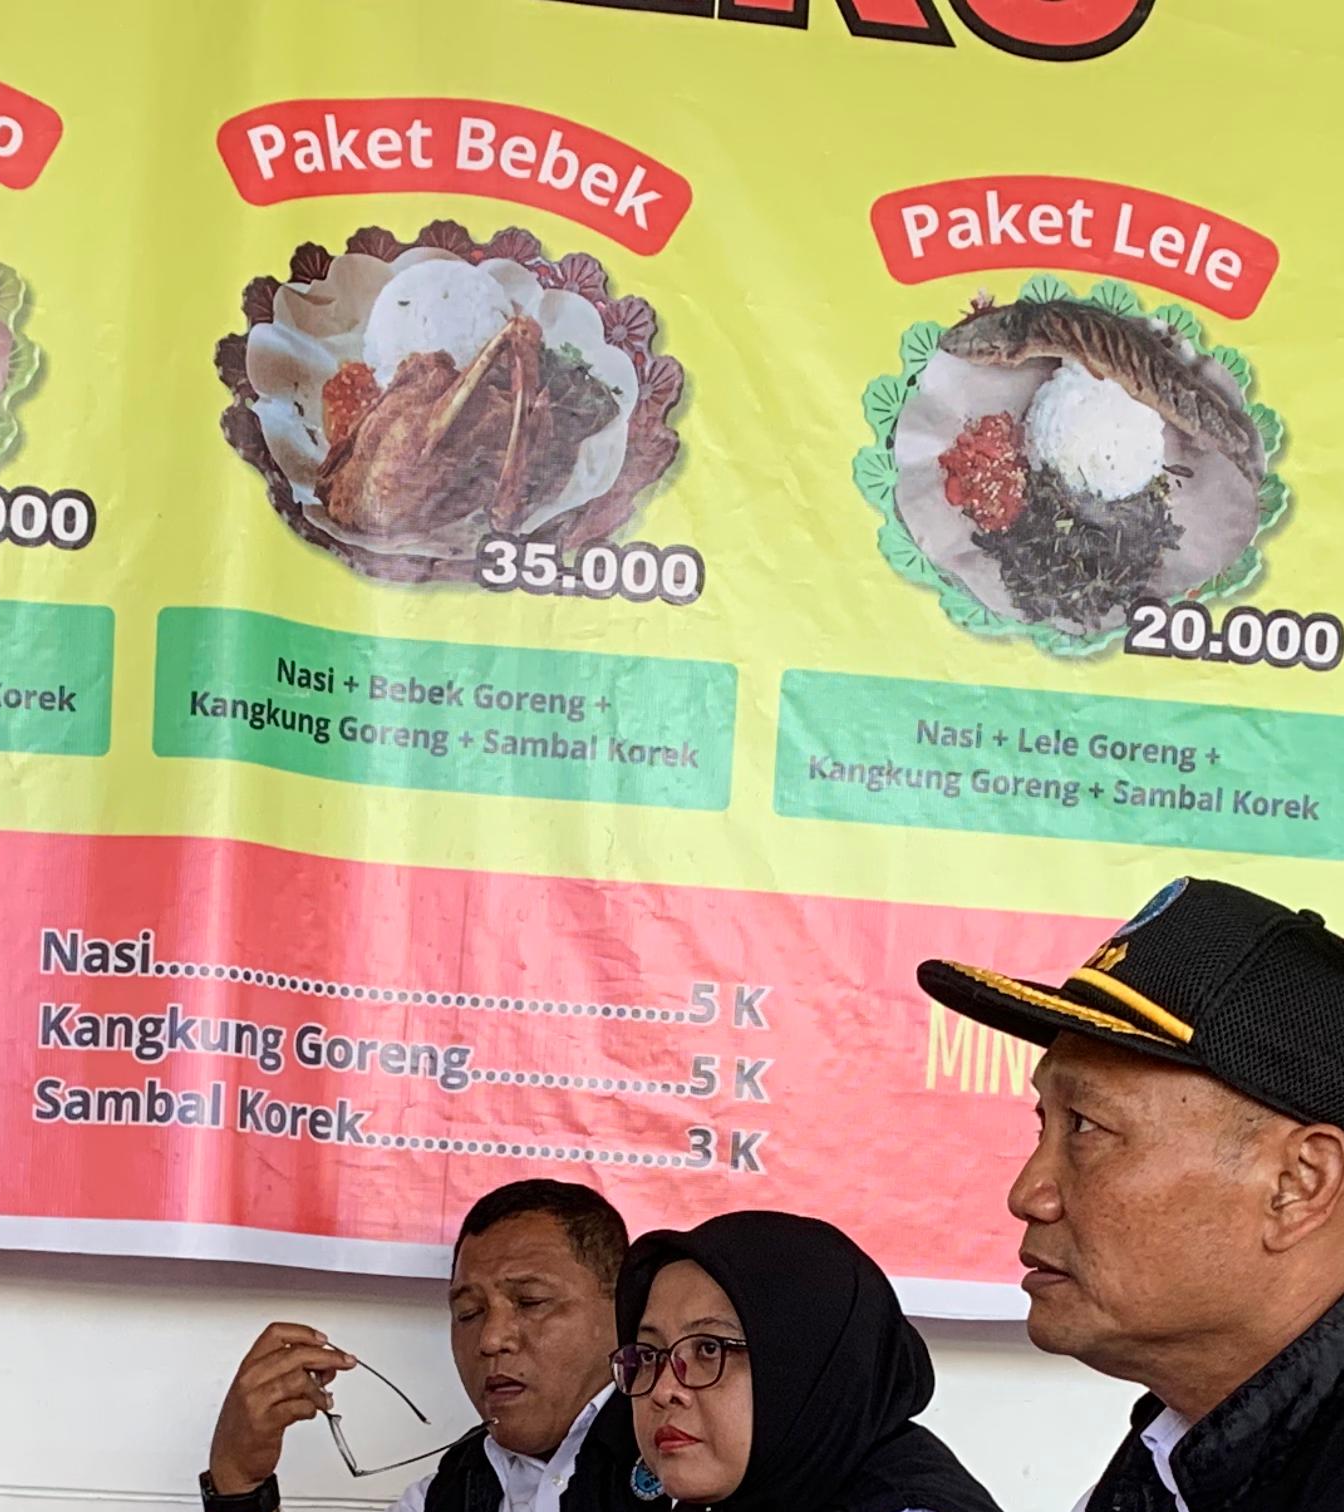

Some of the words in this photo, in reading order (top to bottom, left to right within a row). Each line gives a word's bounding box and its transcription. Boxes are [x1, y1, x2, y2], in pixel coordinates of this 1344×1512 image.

[246, 115, 434, 181] Paket
[455, 117, 664, 232] Bebek
[900, 190, 1094, 259] Paket
[1114, 203, 1244, 292] Lele
[480, 541, 699, 598] 35.000
[1131, 606, 1339, 664] 20.000
[276, 657, 334, 694] Nasi
[368, 675, 463, 706] Bebek
[473, 682, 587, 722] Goreng
[189, 690, 330, 743] Kangkung
[338, 715, 449, 756] Goreng
[482, 727, 597, 761] Sambal
[606, 736, 699, 768] Korek
[915, 719, 983, 749] Nasi
[1017, 727, 1080, 757] Lele
[1087, 734, 1197, 772] Goreng
[808, 755, 961, 797] Kangkung
[970, 766, 1080, 807] Goreng
[1113, 778, 1223, 814] Sambal
[1232, 788, 1321, 822] Korek
[733, 984, 773, 1030] K
[38, 1002, 284, 1071] Kangkung
[733, 1057, 773, 1102] K
[34, 1078, 222, 1126] Sambal
[728, 1129, 767, 1174] K
